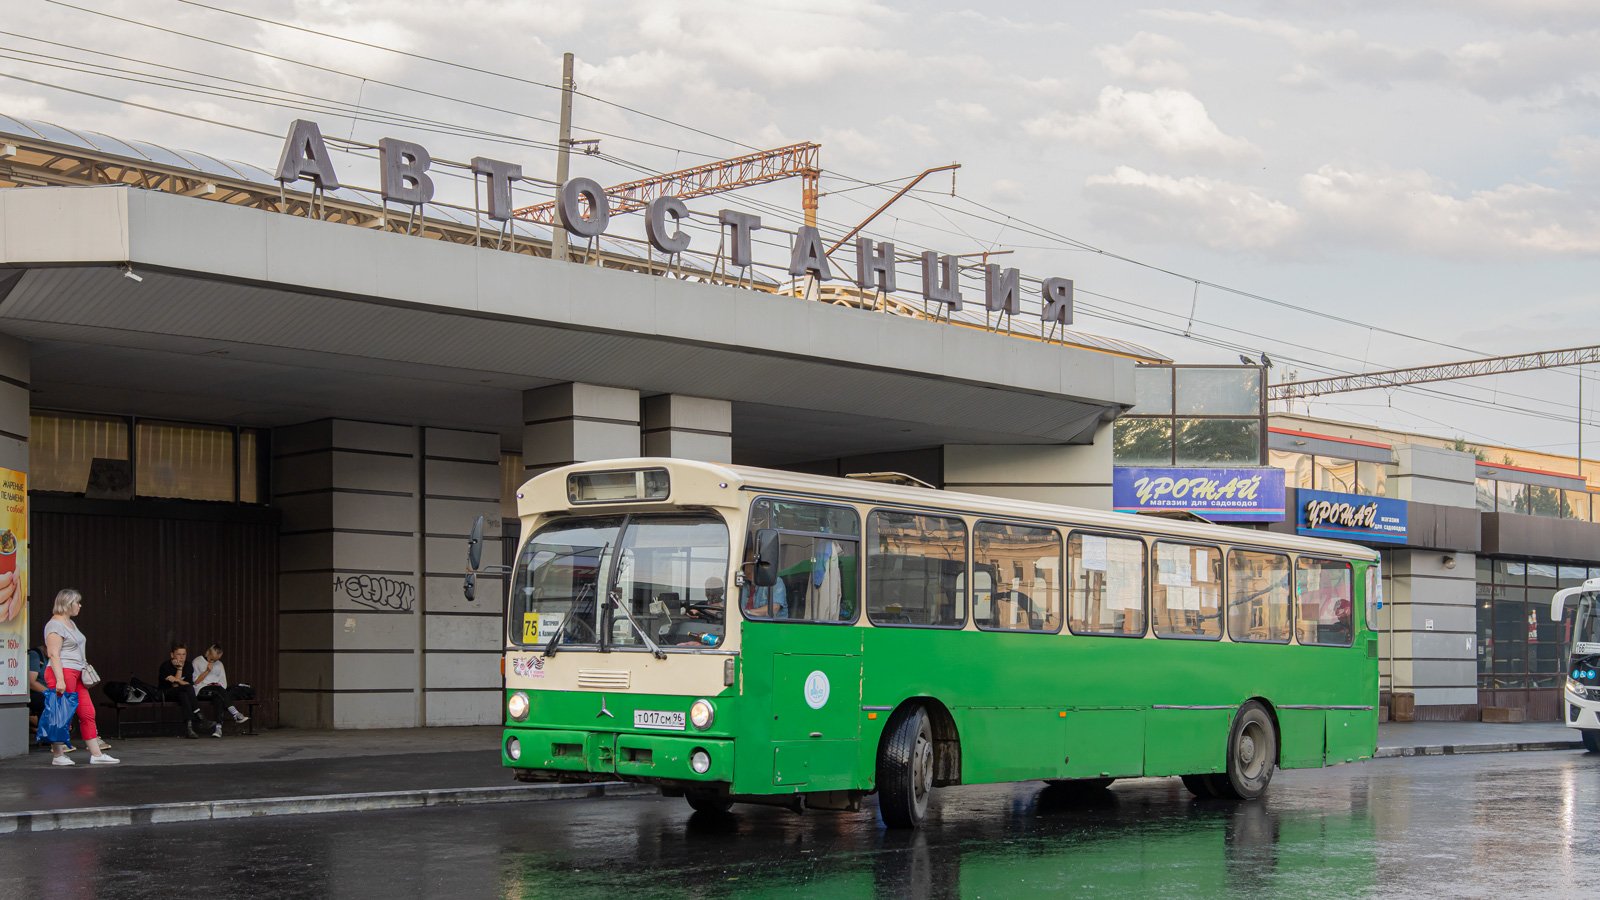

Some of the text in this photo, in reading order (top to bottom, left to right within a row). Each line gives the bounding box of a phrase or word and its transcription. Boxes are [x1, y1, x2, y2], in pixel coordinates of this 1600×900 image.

[274, 118, 1074, 325] АВТОСТАНЦИЯ
[3, 480, 24, 492] ЖАРЕНЫЕ
[1134, 475, 1262, 505] УРОЖАЙ
[1, 491, 24, 502] ПЕЛЬМЕНИ
[1305, 499, 1378, 529] УРОЖАЙ
[1381, 516, 1400, 524] магазин
[1383, 524, 1406, 532] садоводов
[525, 620, 537, 636] 75
[673, 713, 682, 721] 96
